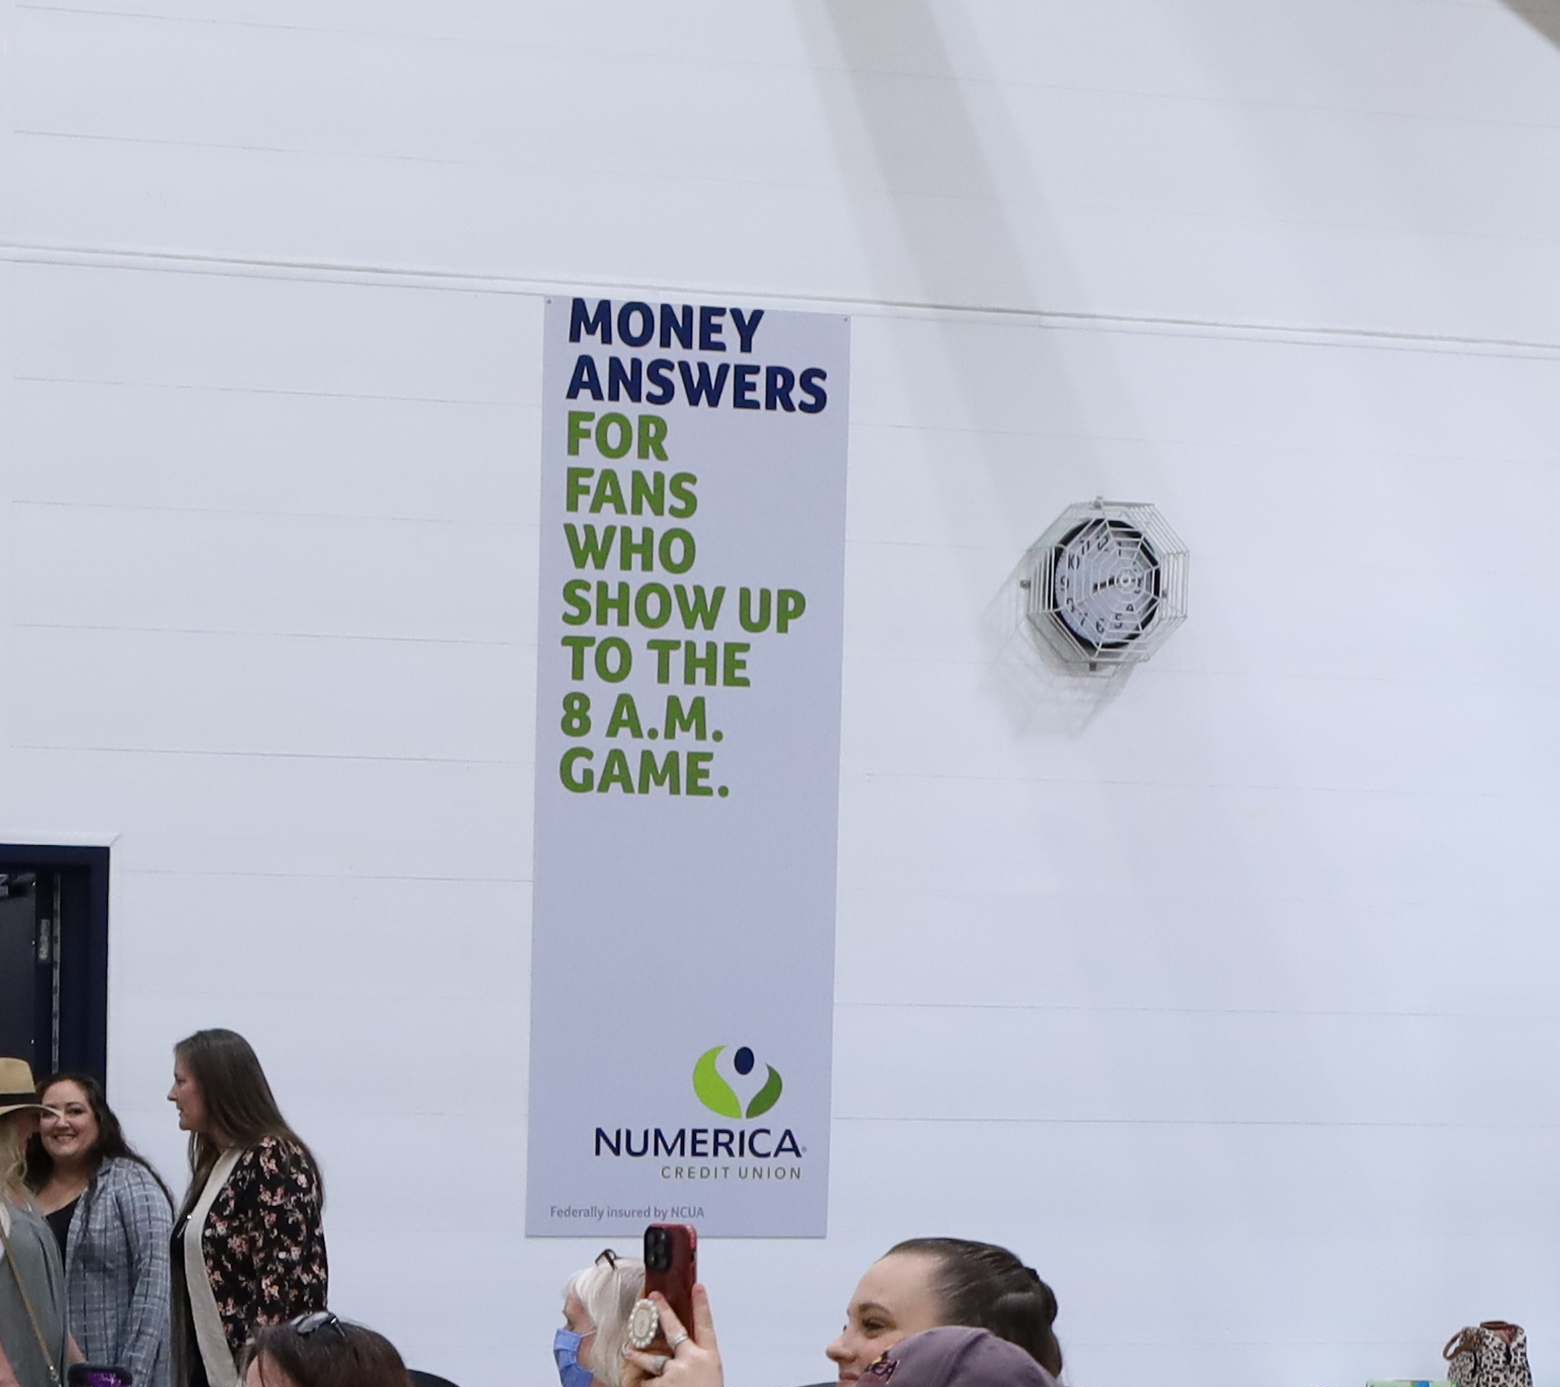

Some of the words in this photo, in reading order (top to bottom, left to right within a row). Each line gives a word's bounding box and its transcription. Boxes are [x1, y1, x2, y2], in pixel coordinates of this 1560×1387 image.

[568, 298, 764, 353] MONEY
[565, 354, 828, 414] ANSWERS
[566, 410, 669, 462] FOR
[565, 466, 698, 519] FANS
[563, 522, 696, 575] WHO
[561, 579, 726, 631] SHOW
[738, 586, 806, 634] UP
[560, 635, 633, 684] TO
[646, 639, 751, 687] THE
[560, 691, 592, 738] 8
[605, 693, 724, 742] A.M.
[559, 746, 730, 798] GAME.
[594, 1127, 803, 1159] NUMERICA
[661, 1166, 730, 1180] CREDIT
[738, 1166, 802, 1180] UNION
[550, 1205, 604, 1221] Federally
[607, 1205, 651, 1219] insured
[654, 1206, 668, 1222] by
[670, 1206, 705, 1219] NCUA
